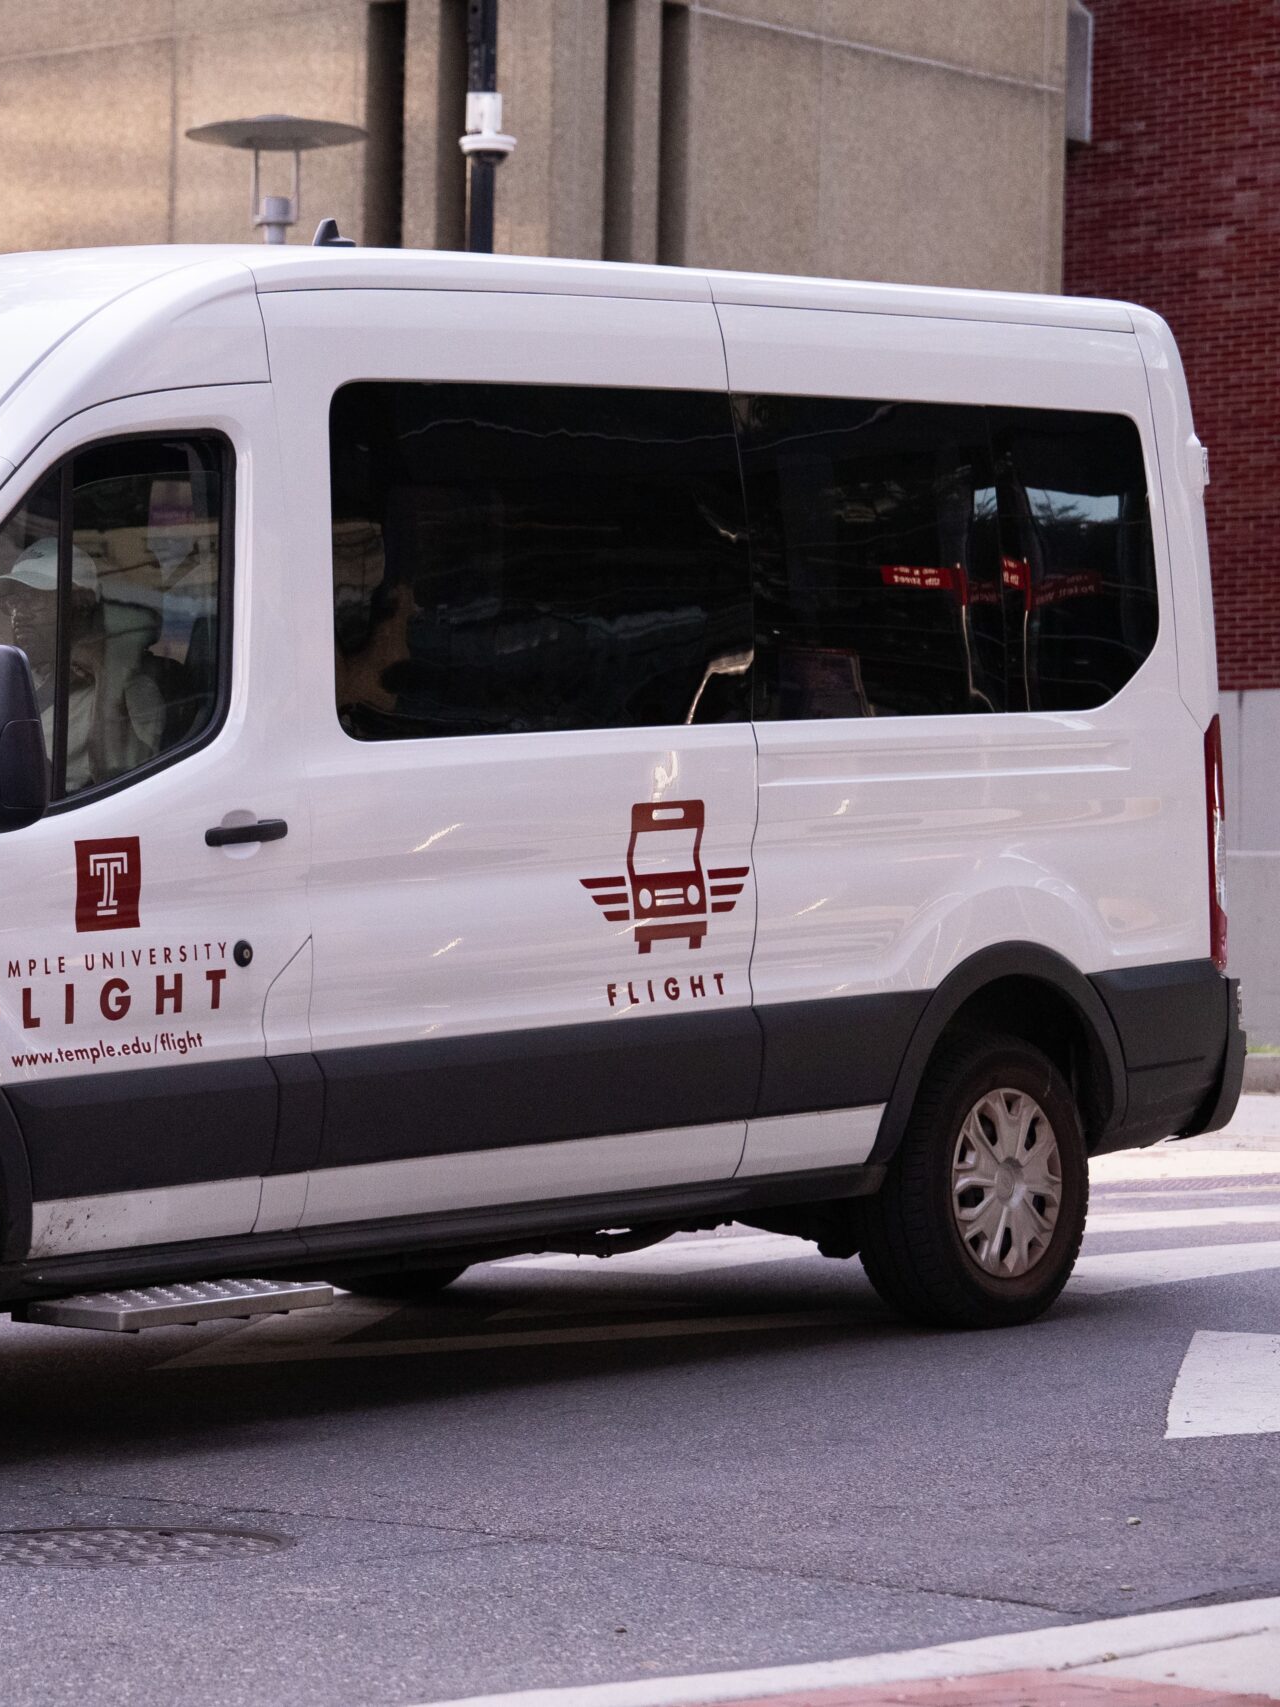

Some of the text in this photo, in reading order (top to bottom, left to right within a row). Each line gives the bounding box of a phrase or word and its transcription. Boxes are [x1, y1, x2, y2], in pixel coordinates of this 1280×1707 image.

[85, 941, 228, 971] UNIVERSITY
[606, 972, 725, 1007] FLIGHT
[11, 1030, 204, 1068] www.temple.edu/flight
